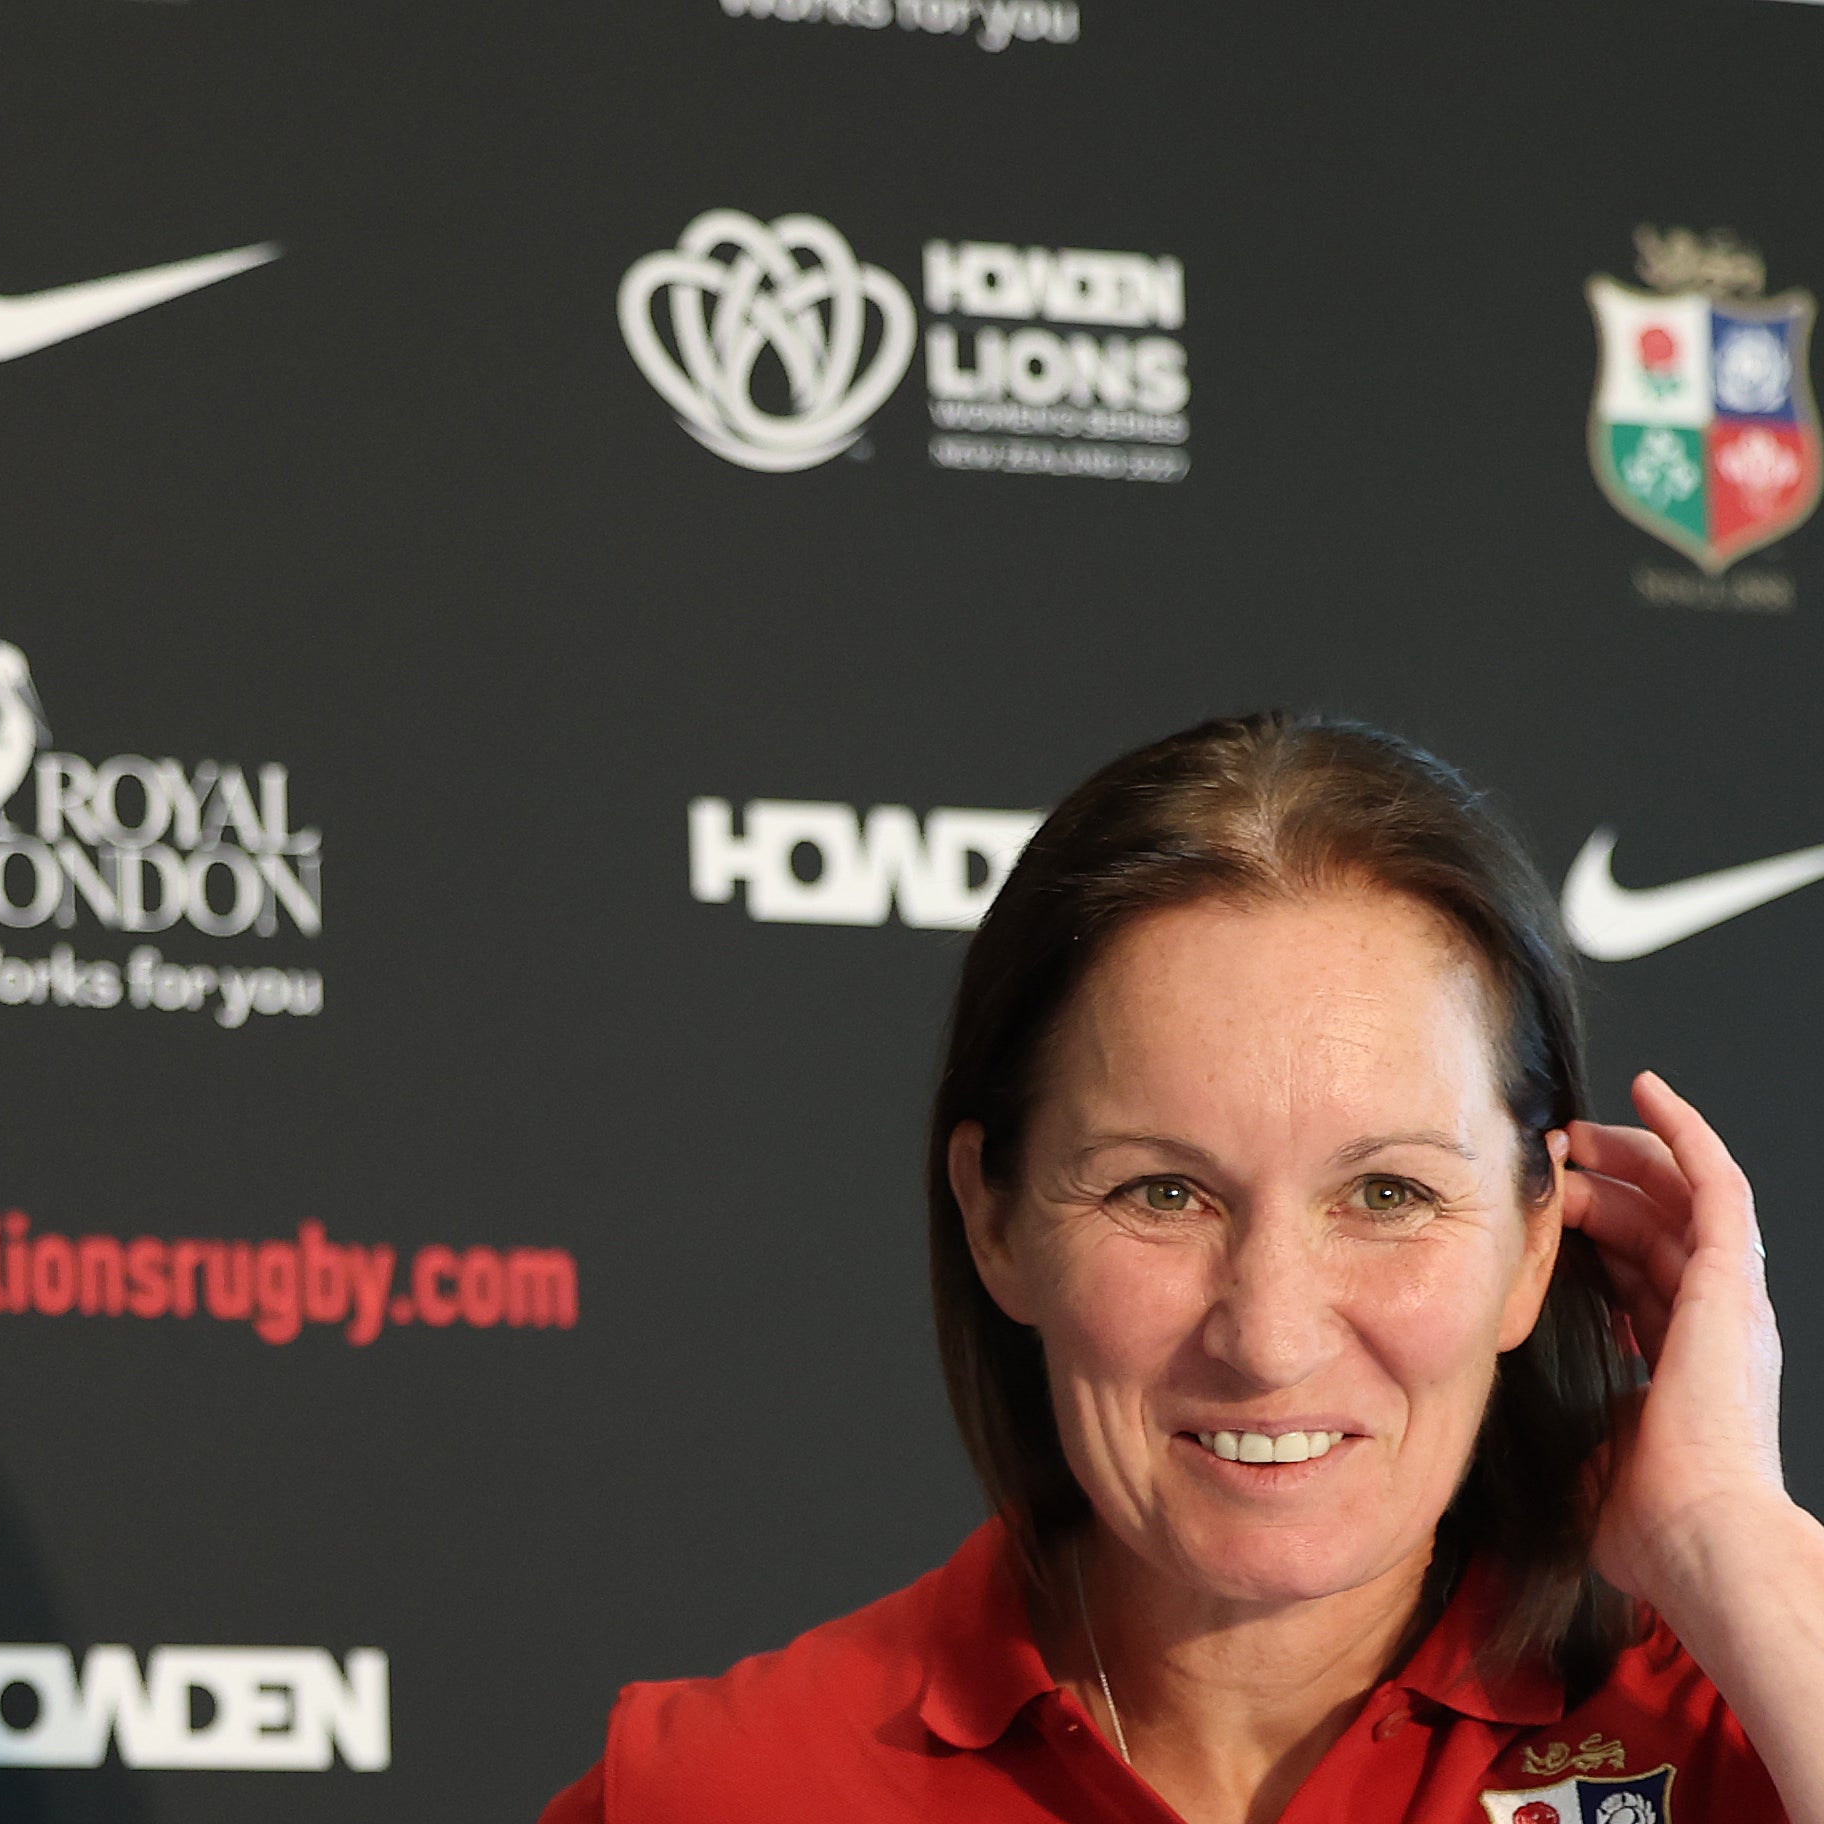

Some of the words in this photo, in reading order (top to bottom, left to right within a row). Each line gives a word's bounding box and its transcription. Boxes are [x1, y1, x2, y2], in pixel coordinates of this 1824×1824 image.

[922, 238, 1187, 330] HOWDEN
[926, 322, 1191, 415] LIONS
[35, 752, 323, 855] ROYAL
[688, 795, 1048, 932] HOWD
[125, 944, 220, 1012] for
[214, 965, 324, 1029] you
